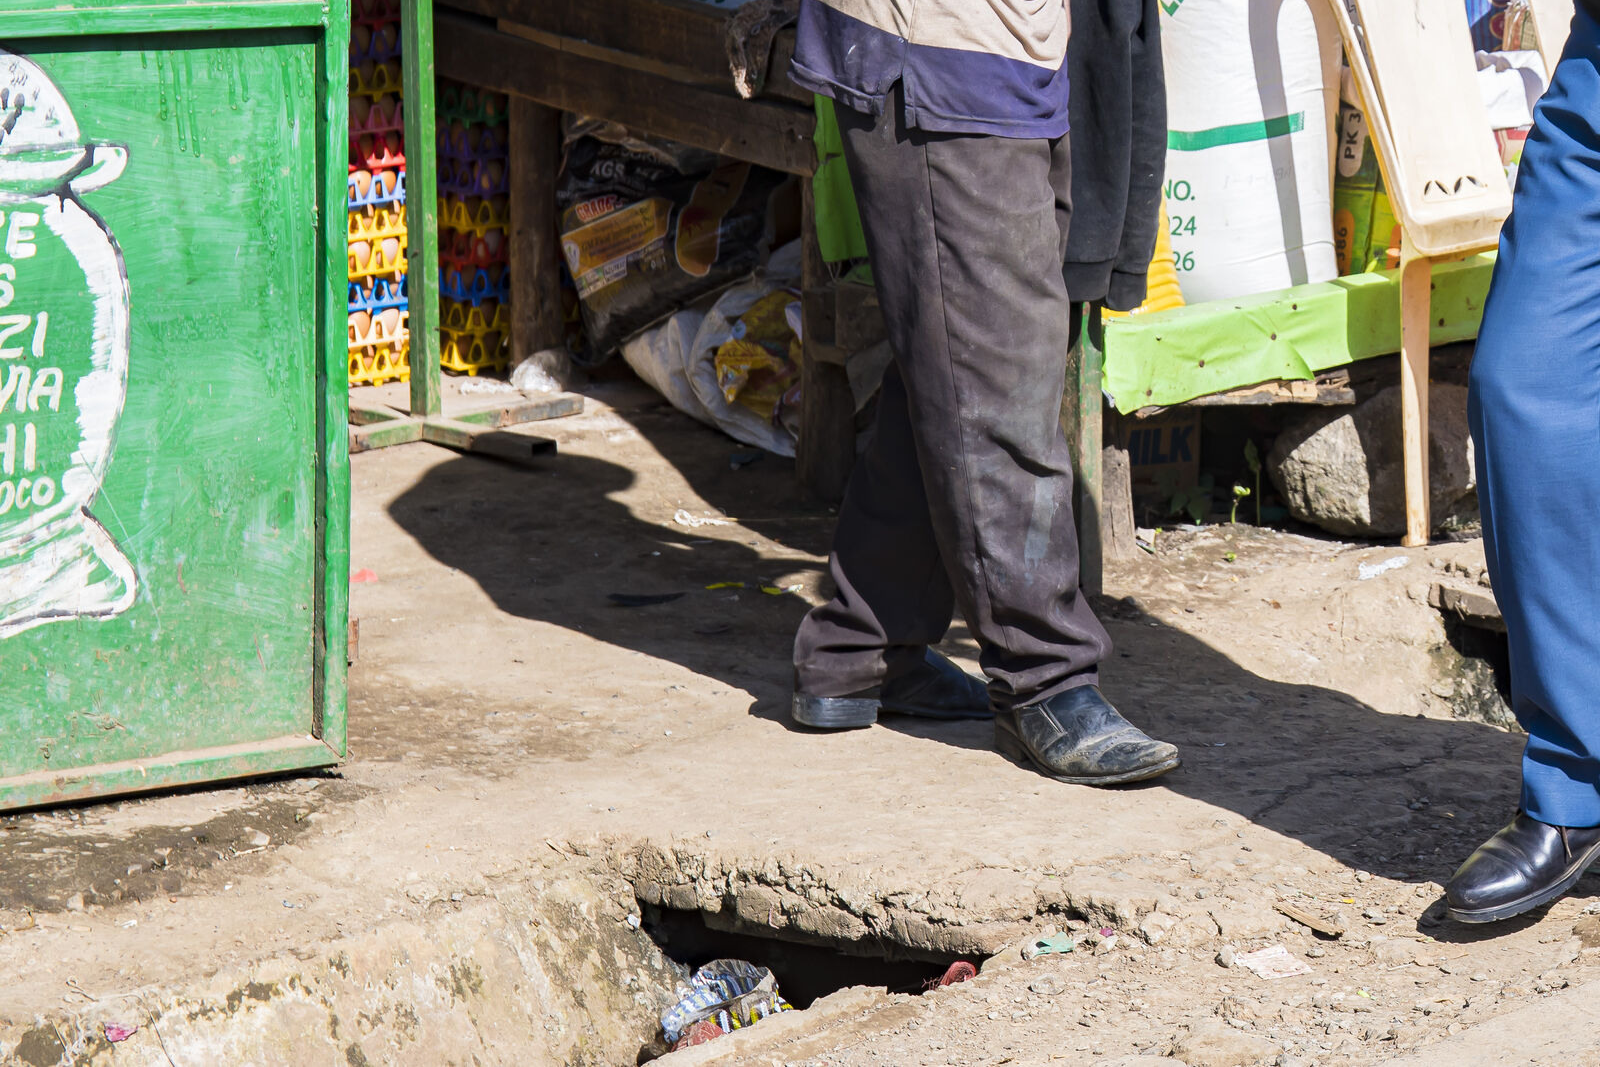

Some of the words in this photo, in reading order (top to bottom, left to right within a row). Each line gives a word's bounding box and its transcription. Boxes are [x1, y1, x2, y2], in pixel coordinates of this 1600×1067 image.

[1349, 111, 1362, 124] 3
[1344, 132, 1360, 160] PK
[1170, 215, 1198, 236] 24
